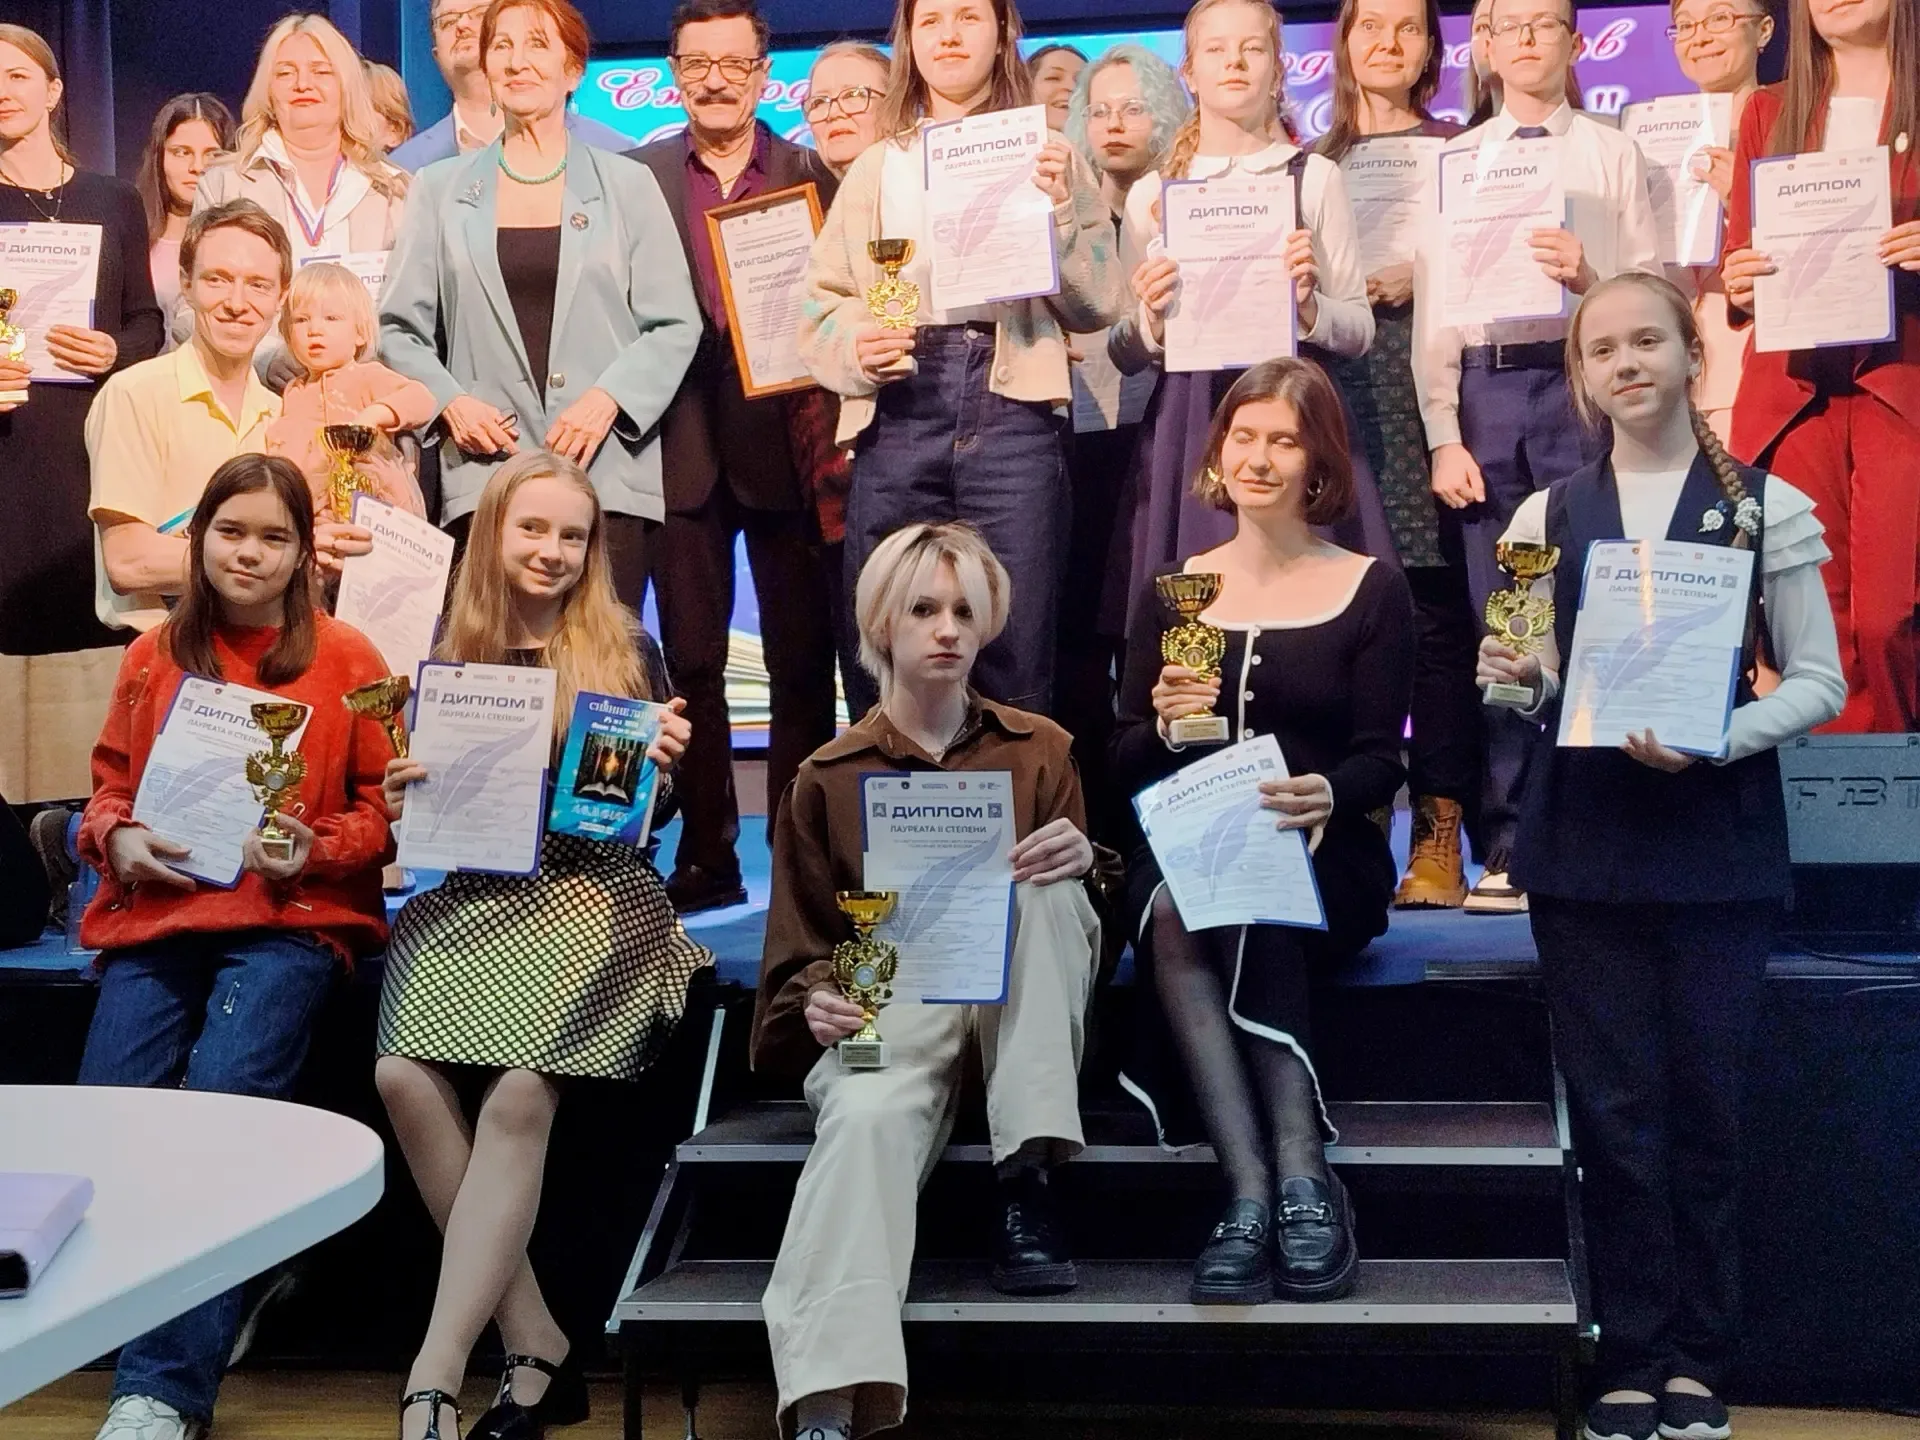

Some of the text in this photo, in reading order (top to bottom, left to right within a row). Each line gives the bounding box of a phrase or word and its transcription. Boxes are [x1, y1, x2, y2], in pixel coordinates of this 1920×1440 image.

[1637, 120, 1704, 135] ДИПЛОМ
[947, 137, 1021, 159] ДИПЛОМ
[944, 158, 981, 171] ЛАУРЕАТА
[991, 152, 1026, 163] СТЕПЕНИ
[1349, 159, 1417, 171] ДИПЛОМ
[1778, 178, 1861, 197] ДИПЛОМ
[1794, 197, 1848, 208] ДИПЛОМАНТ
[1189, 205, 1268, 220] ДИПЛОМ
[1205, 222, 1255, 232] ДИПЛОМАНТ
[8, 244, 77, 255] ДИПЛОМ
[374, 523, 433, 558] ДИПЛОМ
[1671, 588, 1717, 599] СТЕПЕНИ
[441, 692, 526, 709] ДИПЛОМ
[194, 705, 259, 730] ДИПЛО
[438, 708, 480, 719] ЛАУРЕАТА
[487, 713, 526, 722] СТЕПЕНИ
[187, 718, 226, 735] ЛАУРЕАТА
[233, 731, 271, 748] СТЕПЕНИ
[1167, 764, 1256, 805] ДИПЛОМ
[1169, 791, 1214, 813] ЛАУРЕАТА
[1219, 776, 1262, 793] СТЕПЕНИ
[892, 806, 983, 819] ДИПЛОМ
[890, 825, 935, 833] ЛАУРЕАТА
[945, 825, 987, 833] СТЕПЕНИ
